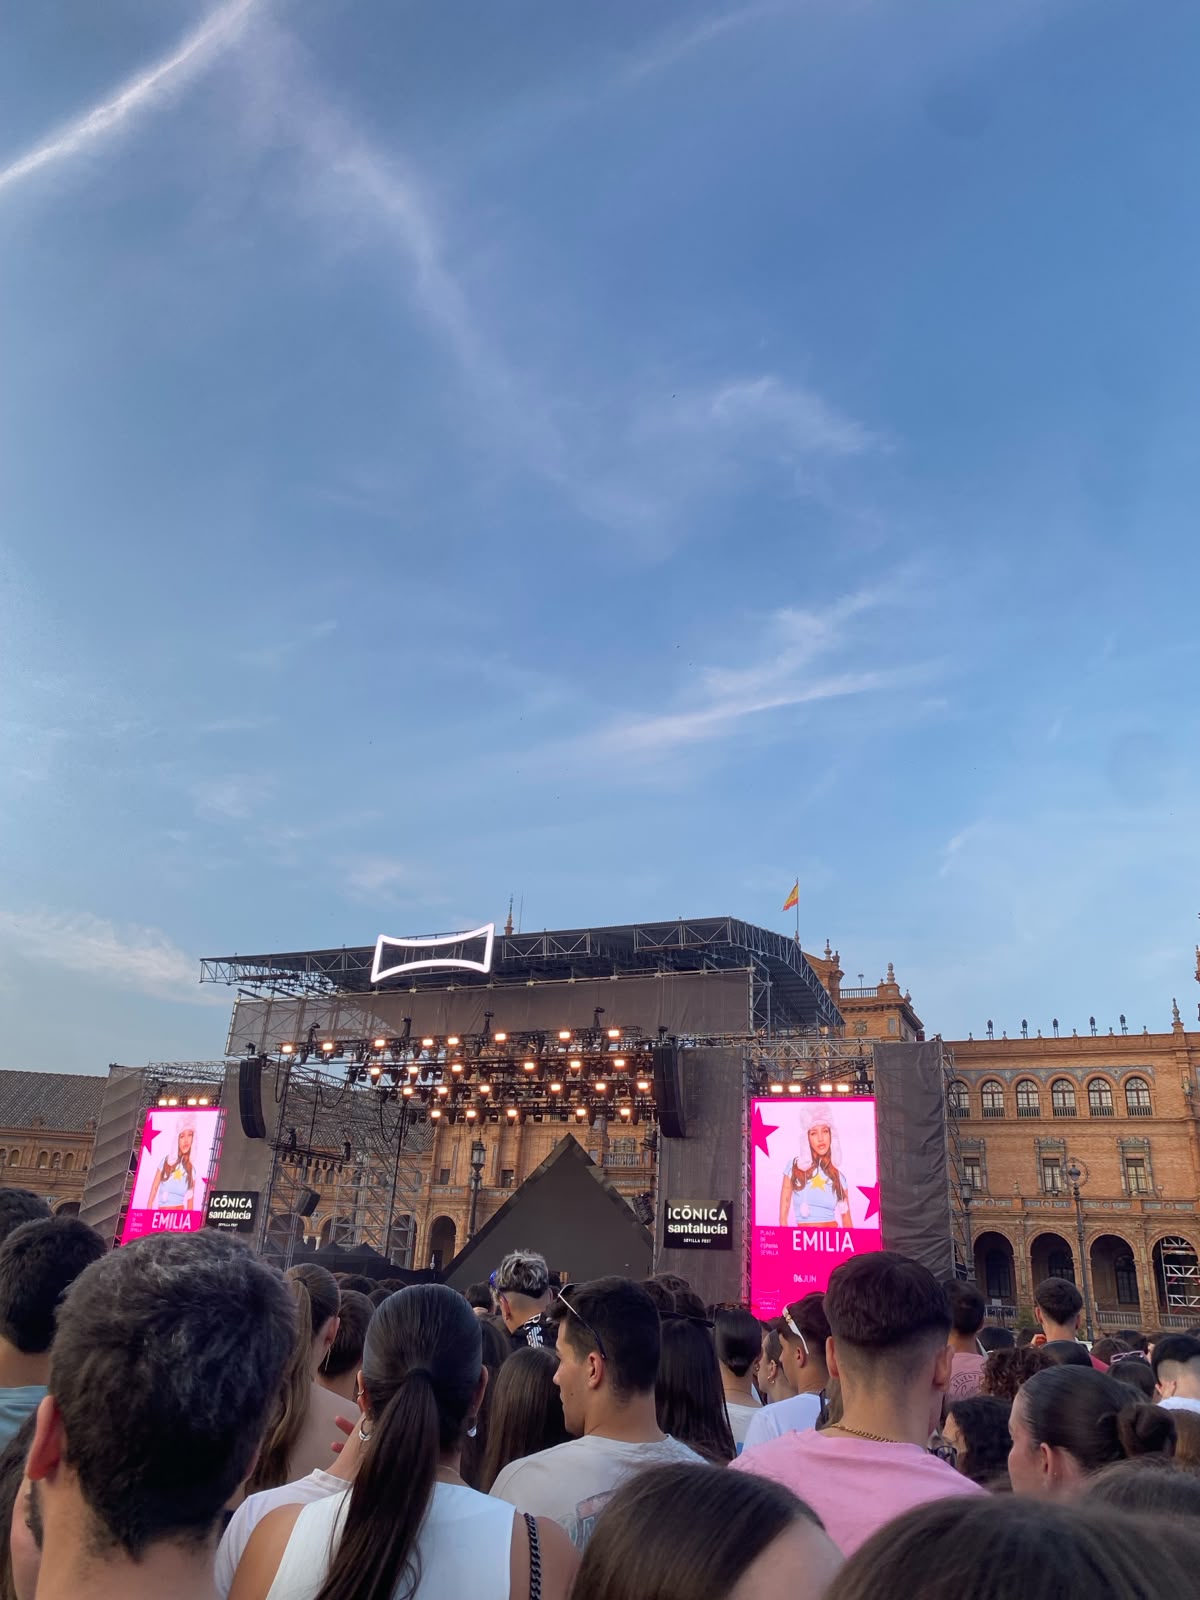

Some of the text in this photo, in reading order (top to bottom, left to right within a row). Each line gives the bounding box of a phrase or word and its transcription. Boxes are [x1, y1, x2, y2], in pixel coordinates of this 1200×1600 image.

[208, 1210, 251, 1220] santalucía
[668, 1205, 728, 1220] ICŌNICA
[152, 1212, 191, 1229] EMILIA
[668, 1223, 728, 1234] santalucía
[793, 1230, 855, 1252] EMILIA
